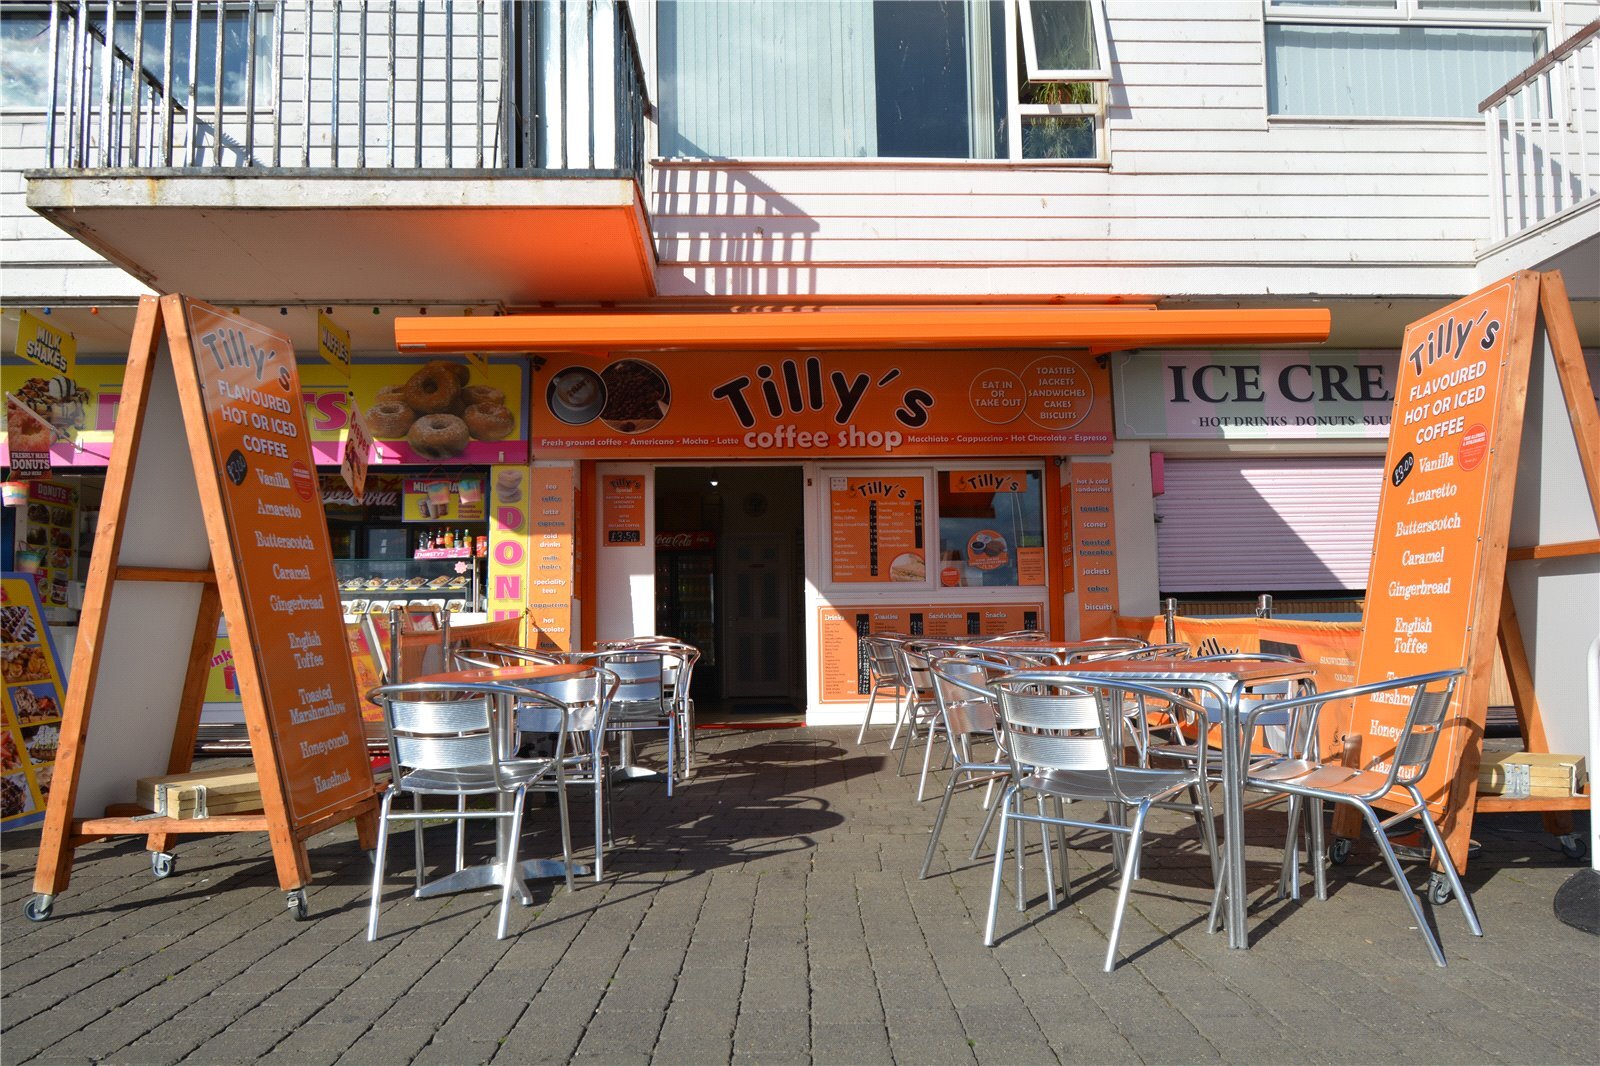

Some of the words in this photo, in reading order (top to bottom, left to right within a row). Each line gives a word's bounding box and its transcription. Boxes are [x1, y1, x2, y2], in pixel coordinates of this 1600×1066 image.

[37, 326, 62, 351] MILK
[1409, 309, 1500, 377] Tilly's
[27, 340, 67, 373] SHAKES
[201, 327, 291, 392] Tilly's
[1036, 367, 1076, 375] TOASTIES
[1409, 360, 1487, 402] FLAVOURED
[712, 356, 935, 429] Tilly's
[982, 381, 999, 389] EAT
[1002, 381, 1013, 389] IN
[1039, 378, 1074, 386] JACKETS
[1167, 364, 1266, 403] ICE
[1278, 364, 1395, 403] CRE
[217, 379, 291, 415] FLAVOURED
[975, 399, 999, 407] TAKE
[1002, 398, 1022, 407] OUT
[991, 389, 1005, 398] OR
[1028, 389, 1086, 397] SANDWICHES
[1043, 400, 1072, 408] CAKES
[1403, 403, 1430, 426] HOT
[1432, 396, 1451, 416] OR
[1453, 385, 1486, 410] ICED
[221, 404, 249, 427] HOT
[251, 411, 270, 430] OR
[271, 417, 297, 438] ICED
[1040, 411, 1077, 419] BISCUITS
[1199, 416, 1231, 427] HOT
[1234, 416, 1288, 427] DRINKS
[1295, 415, 1356, 426] DONUTS
[743, 424, 829, 449] coffee
[838, 424, 903, 452] shop
[908, 434, 949, 443] Macchiato
[956, 434, 1003, 444] Cappuccino
[1011, 433, 1028, 442] Hot
[1029, 433, 1067, 442] Chocolate
[1074, 434, 1107, 443] Espresso
[1415, 416, 1465, 445] COFFEE
[242, 434, 289, 459] COFFEE
[541, 438, 564, 447] Fresh
[566, 438, 595, 448] ground
[597, 437, 622, 446] coffee
[630, 437, 675, 446] Americano
[682, 437, 709, 446] Mocha
[717, 437, 739, 446] Latte
[12, 459, 51, 470] DONUTS
[1418, 452, 1454, 474] Vanilla
[255, 467, 291, 489] Vanilla
[967, 473, 1019, 491] Tilly's
[38, 484, 68, 499] DONUTS
[857, 480, 907, 499] Tilly's
[1407, 483, 1457, 505] Amaretto
[257, 498, 302, 519] Amaretto
[1395, 512, 1461, 538] Butterscotch
[254, 530, 314, 551] Butterscotch
[1402, 547, 1444, 566] Caramel
[272, 563, 310, 581] Caramel
[534, 579, 566, 587] speciality
[1388, 578, 1451, 601] Gingerbread
[269, 594, 324, 615] Gingerbread
[1084, 603, 1113, 611] biscuits
[1394, 617, 1432, 636] English
[288, 631, 321, 652] English
[1394, 637, 1428, 654] Toffee
[294, 653, 324, 670] Toffee
[298, 684, 332, 705] Toasted
[289, 701, 346, 726] Marshmallow
[300, 732, 349, 760] Honeycomb
[314, 769, 351, 794] Hazelnut
